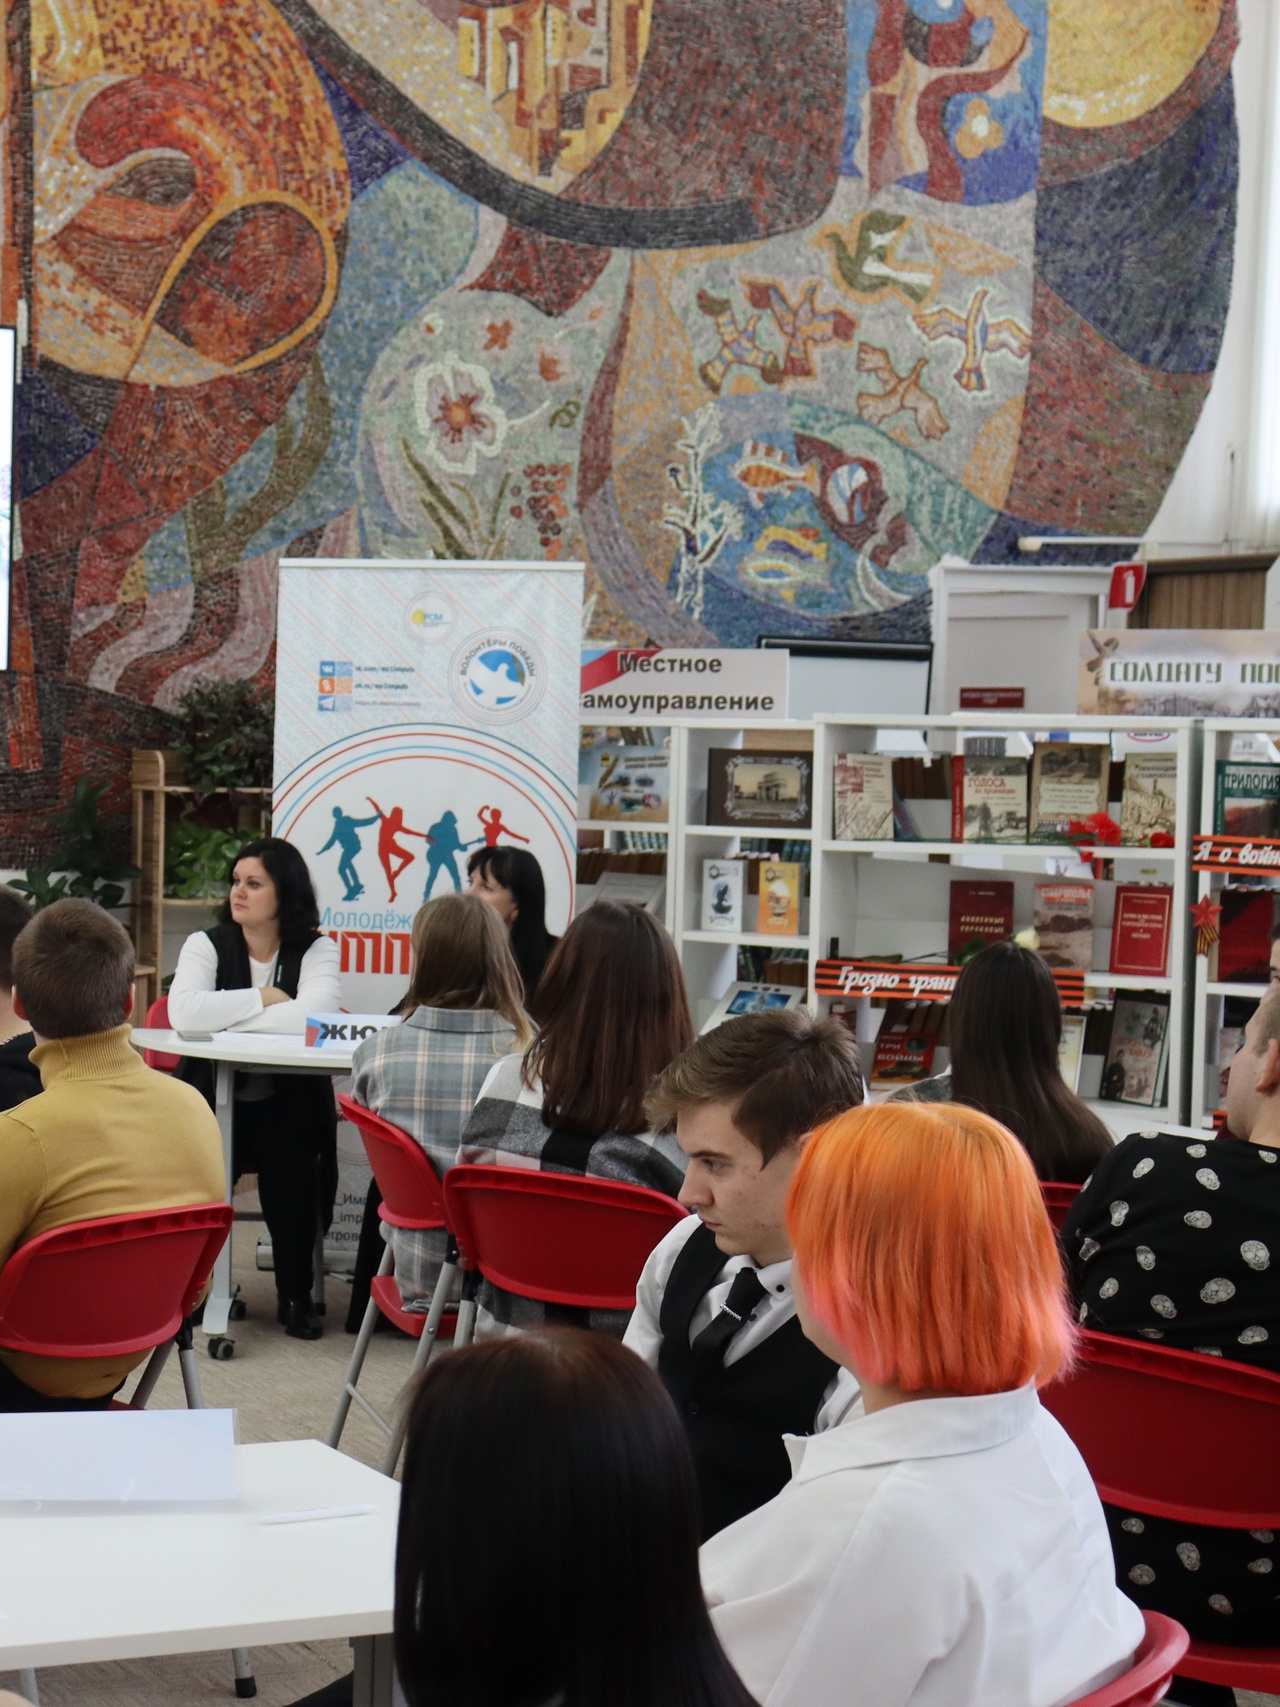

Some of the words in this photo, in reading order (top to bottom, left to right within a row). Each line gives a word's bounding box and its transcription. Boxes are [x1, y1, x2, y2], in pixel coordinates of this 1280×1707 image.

[460, 638, 507, 676] ВОЛОНТЁРЫ
[509, 641, 536, 677] ПОБЕДЫ
[619, 652, 722, 673] Местное
[1110, 661, 1222, 683] СОЛДАТУ
[580, 694, 774, 714] амоуправление
[968, 777, 1006, 788] ГОЛОСА
[1226, 773, 1280, 789] ТРИЛОГИЯ
[1194, 841, 1213, 861] Я
[1219, 847, 1232, 863] о
[838, 966, 900, 994] Грозно
[320, 1023, 388, 1040] ЖЮ
[877, 1053, 924, 1062] ВОЙНЫ
